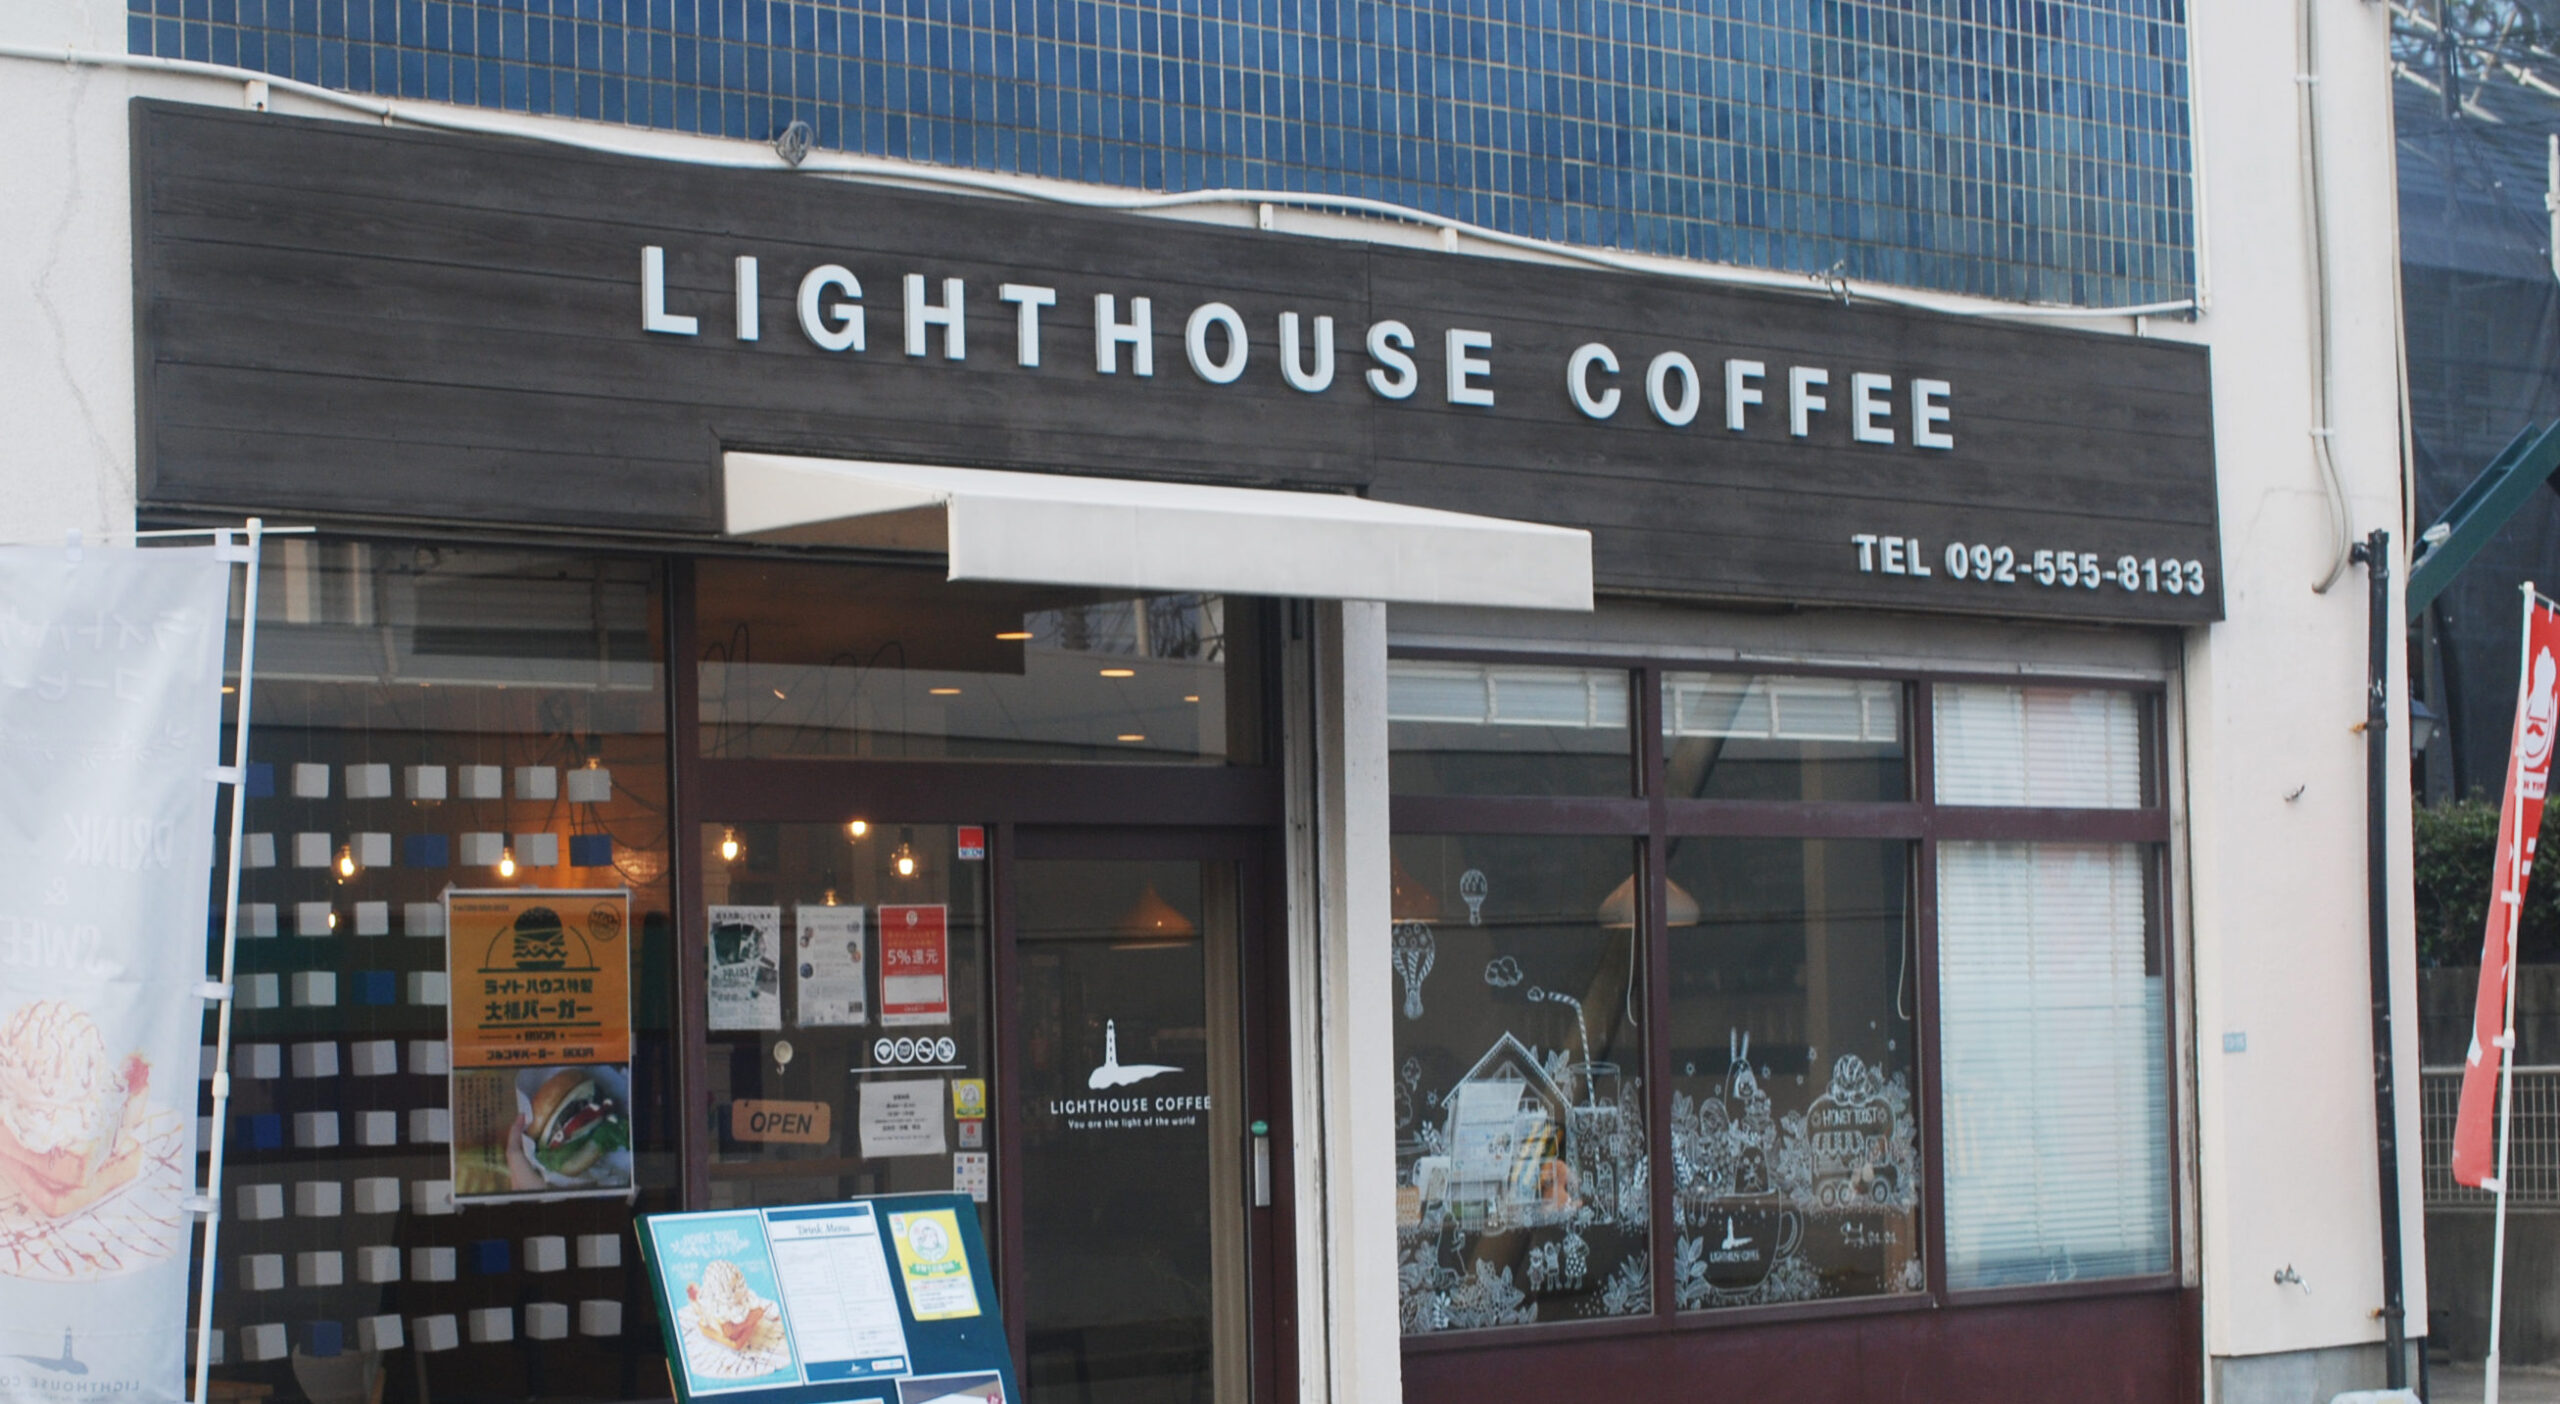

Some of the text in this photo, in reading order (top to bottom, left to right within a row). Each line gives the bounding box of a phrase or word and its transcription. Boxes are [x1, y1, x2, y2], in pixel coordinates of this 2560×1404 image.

[642, 246, 1954, 449] LIGHTHOUSE COFFEE
[1852, 534, 2205, 595] TEL 092-555-8133
[887, 948, 939, 966] 5%還元
[1050, 1096, 1212, 1115] LIGHTHOUSE COFFEE
[750, 1111, 813, 1135] OPEN
[1067, 1115, 1196, 1130] You are the light of the world
[796, 1222, 851, 1238] Drink Menu
